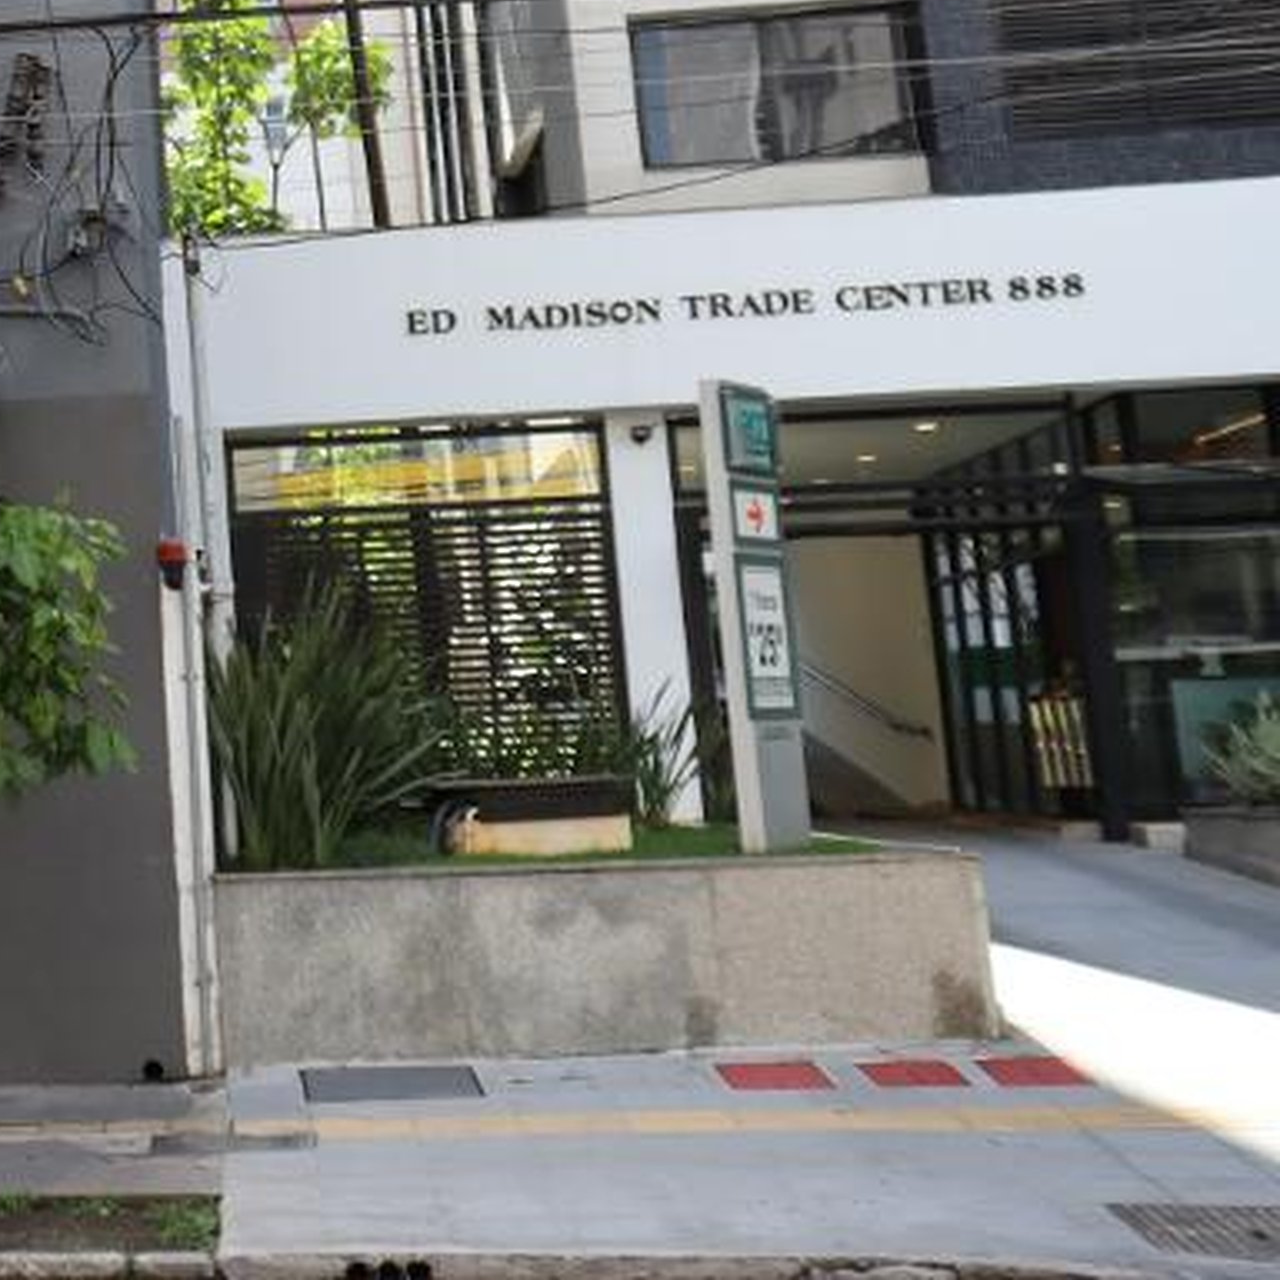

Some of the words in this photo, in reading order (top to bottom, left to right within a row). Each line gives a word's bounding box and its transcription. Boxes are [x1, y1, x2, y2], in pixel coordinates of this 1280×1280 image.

[406, 309, 458, 336] ED
[485, 298, 662, 332] MADISON
[679, 289, 815, 322] TRADE
[834, 278, 994, 312] CENTER
[1007, 273, 1086, 301] 888
